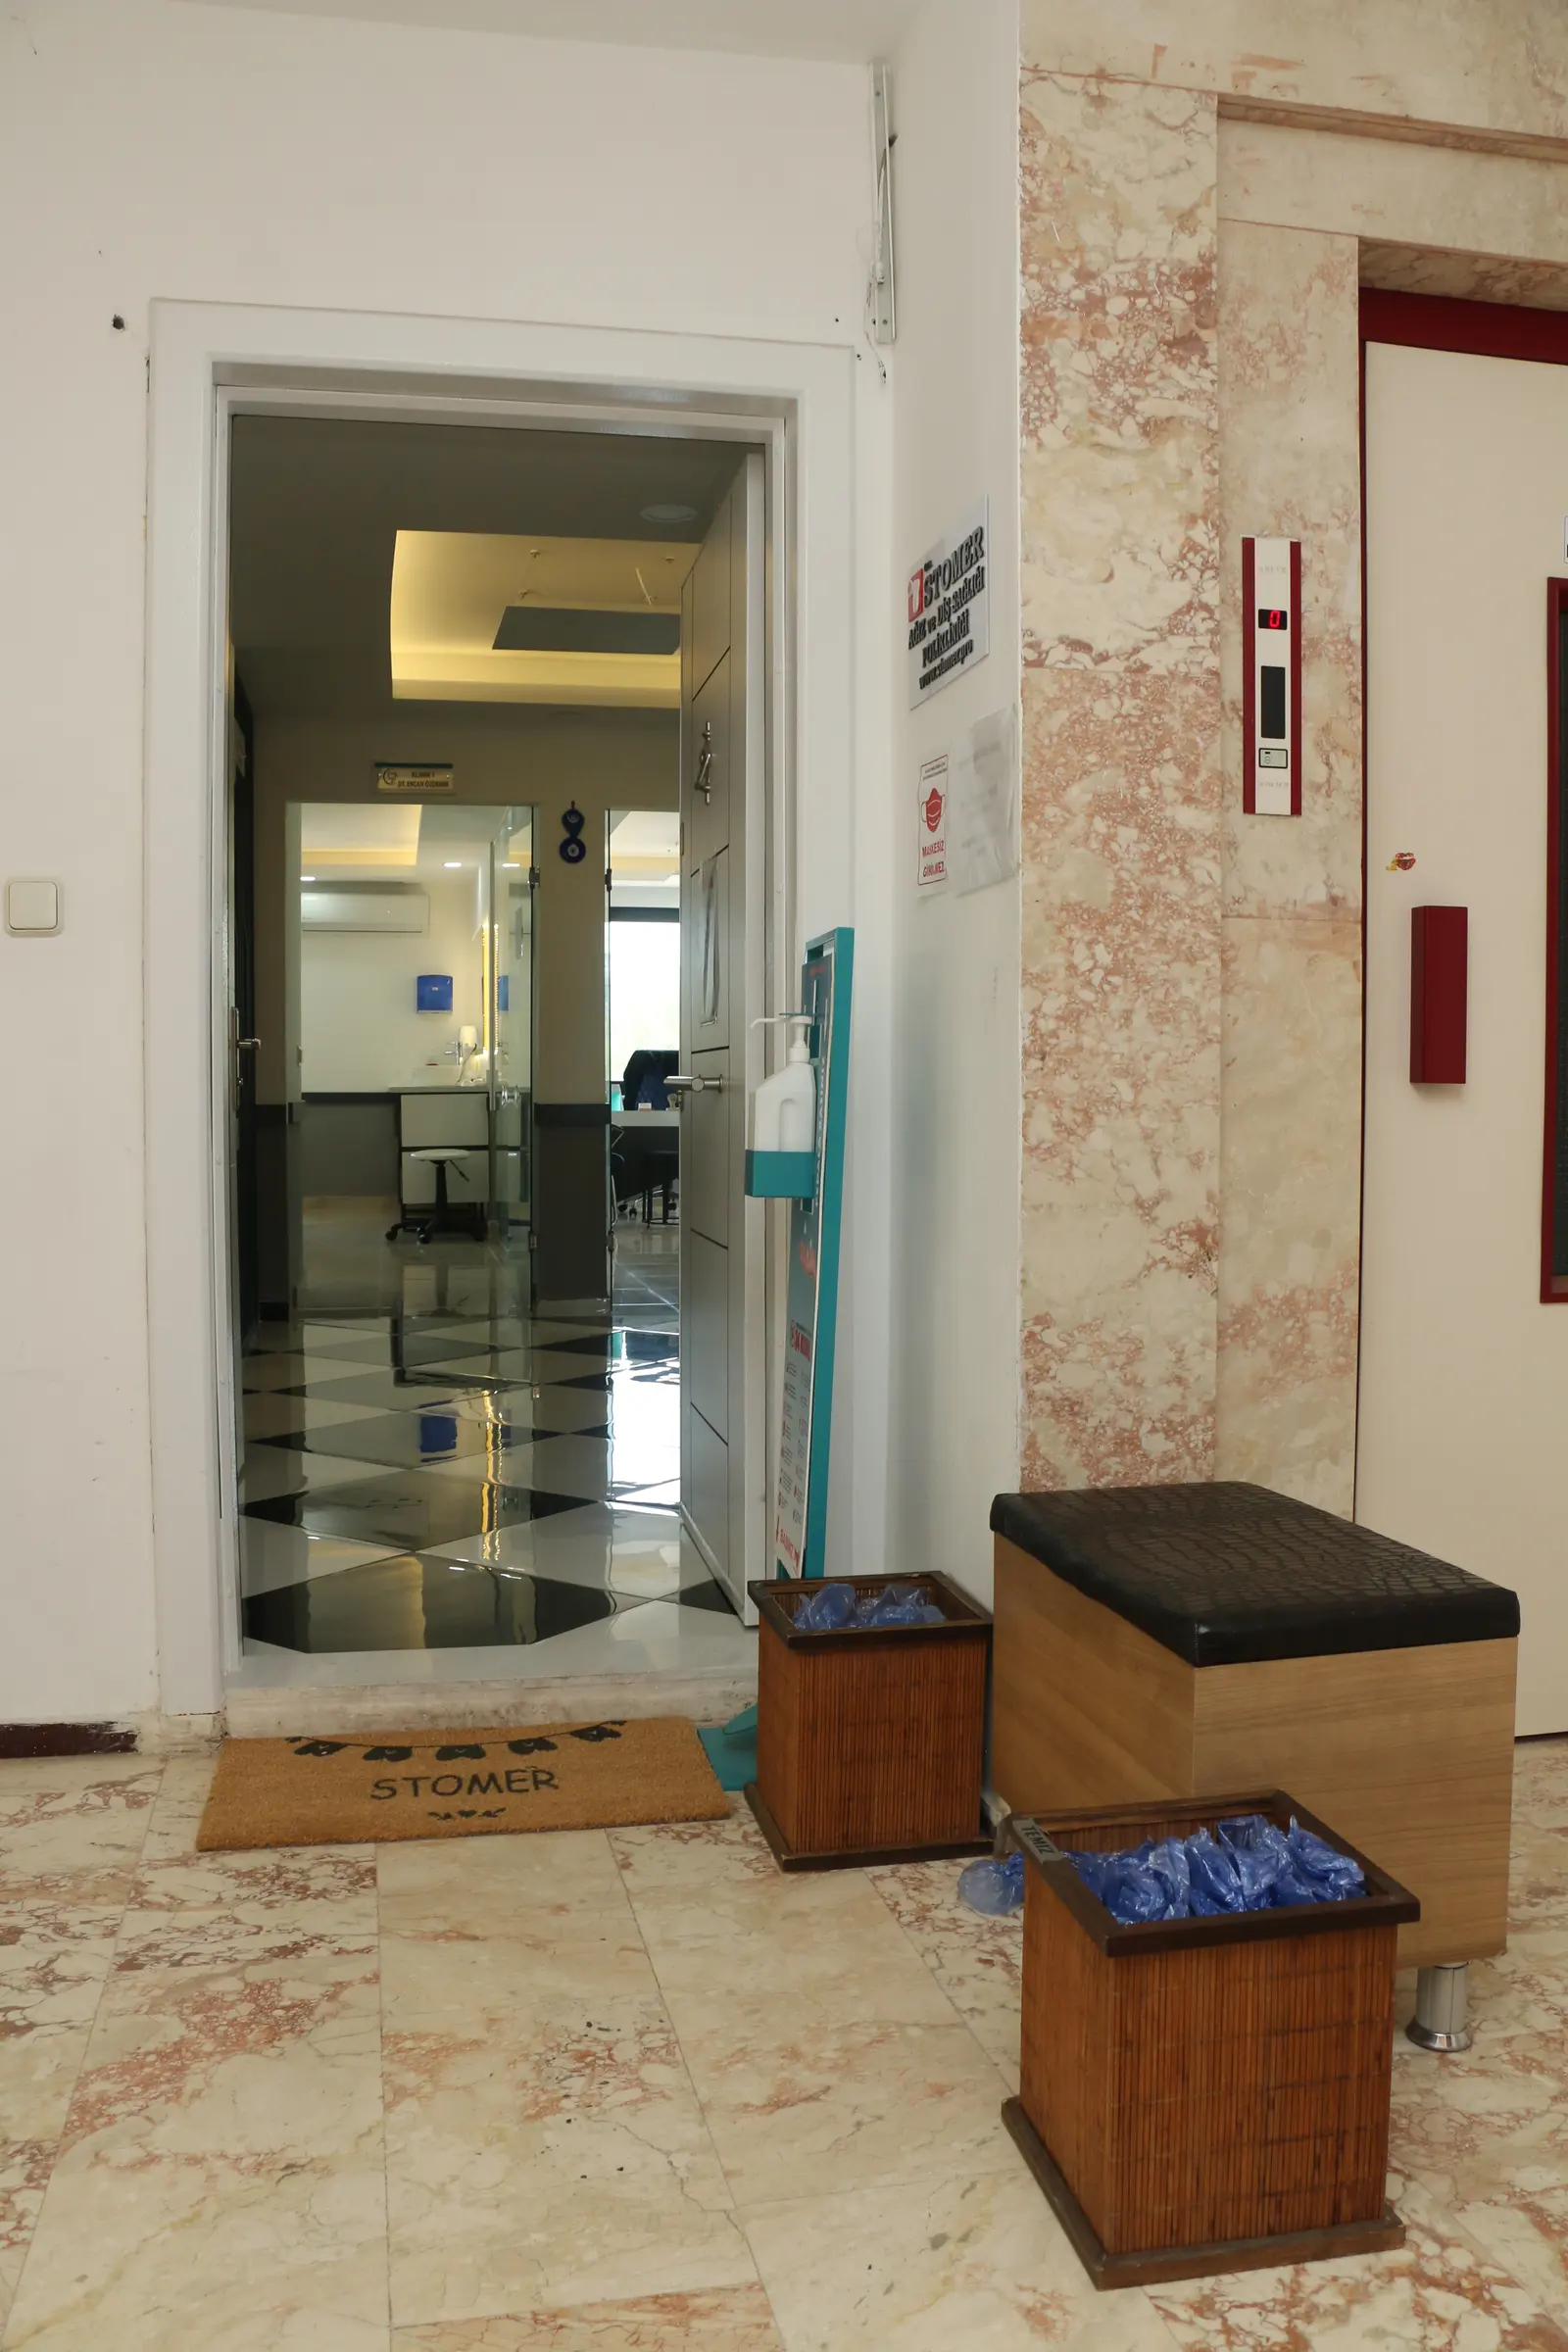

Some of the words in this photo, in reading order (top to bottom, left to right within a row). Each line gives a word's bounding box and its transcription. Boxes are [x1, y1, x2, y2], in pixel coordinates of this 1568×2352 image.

[924, 525, 984, 608] STOMER
[937, 596, 952, 627] DİŞ
[1269, 610, 1280, 628] 0
[370, 1766, 559, 1800] STOMER
